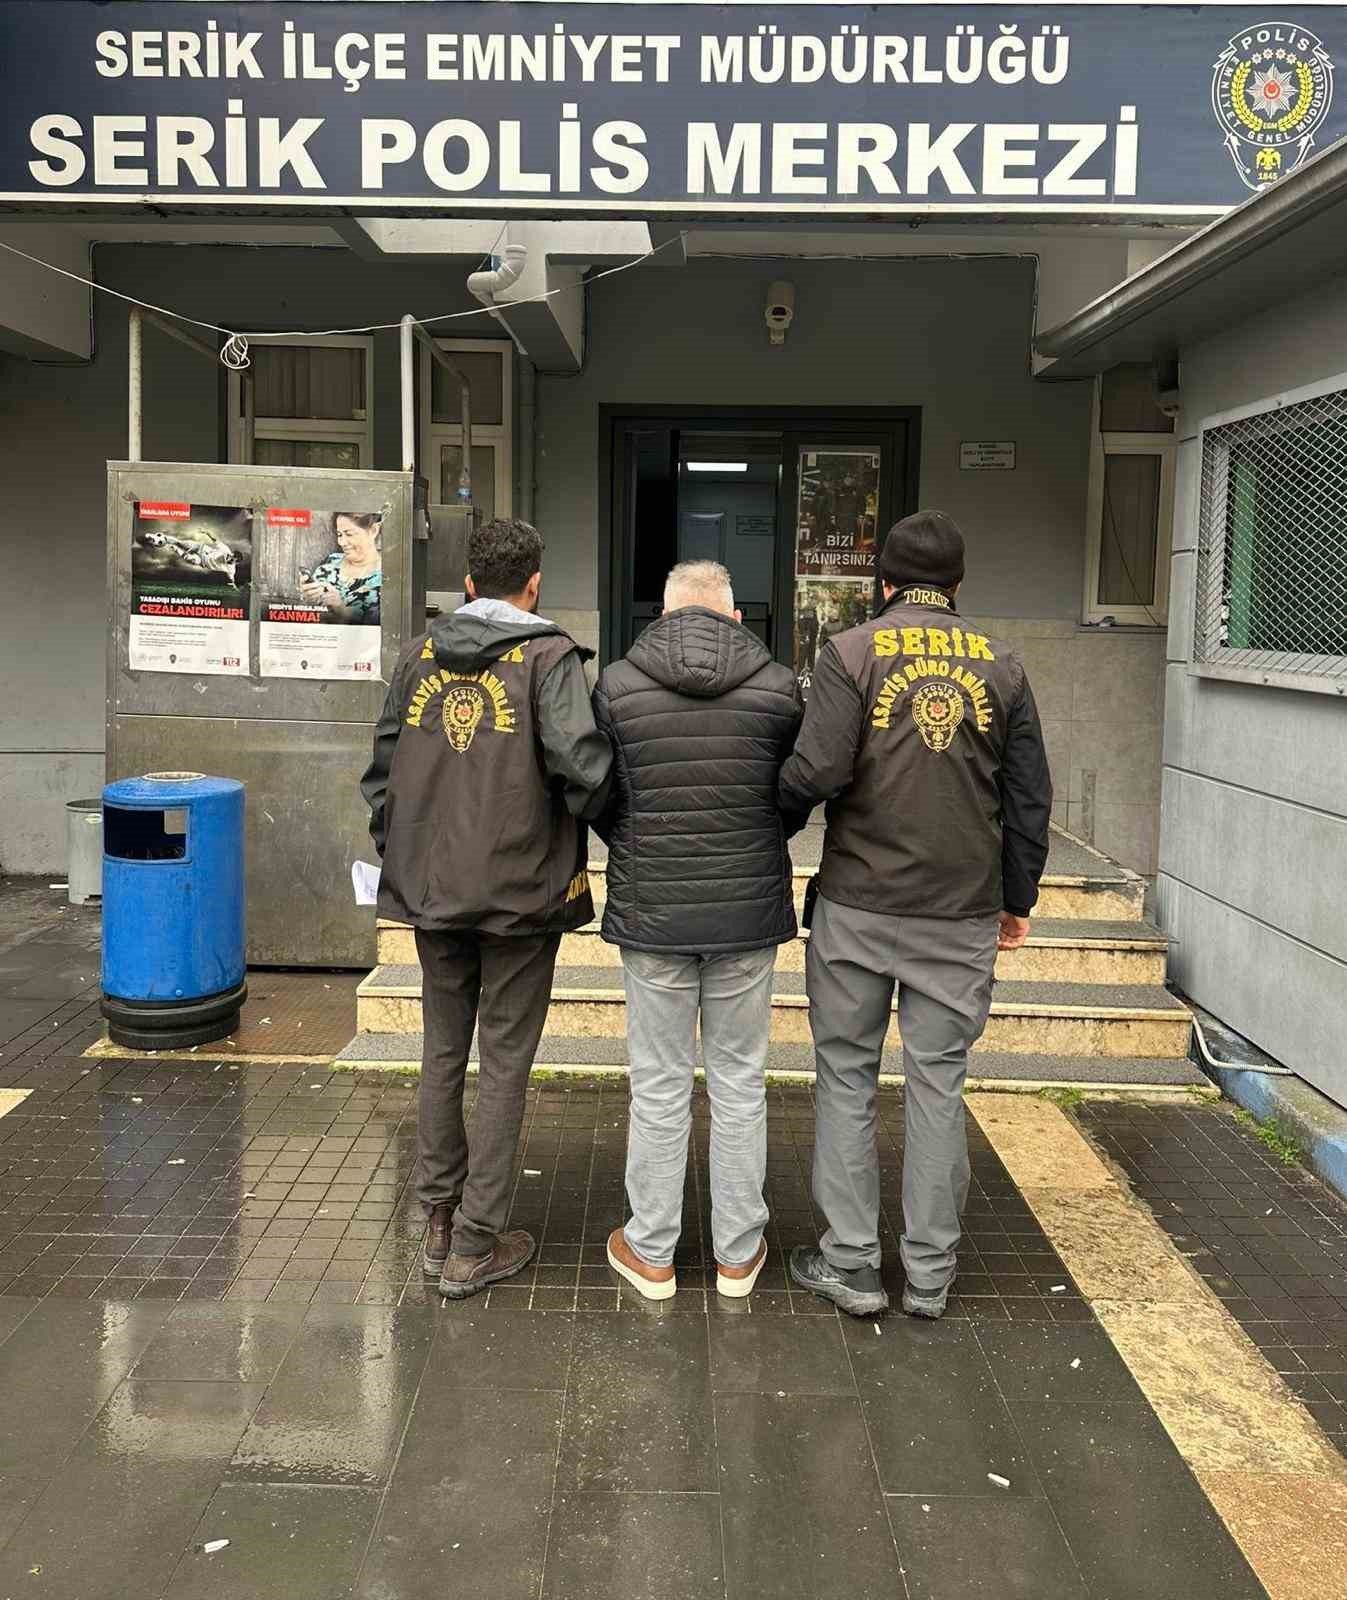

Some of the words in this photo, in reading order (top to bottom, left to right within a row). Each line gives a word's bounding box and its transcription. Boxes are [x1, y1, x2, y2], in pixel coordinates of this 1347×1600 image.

[1241, 29, 1310, 51] POLİS
[96, 21, 264, 78] SERİK
[284, 21, 405, 92] İLÇE
[427, 24, 680, 82] EMNİYET
[701, 24, 1069, 84] MÜDÜRLÜĞÜ
[1247, 131, 1291, 143] GENEL
[29, 100, 326, 188] SERİK
[362, 103, 648, 193] POLİS
[687, 106, 1138, 195] MERKEZİ
[826, 531, 854, 547] BİZİ
[803, 552, 876, 567] TANIRSINIZ
[139, 603, 244, 619] CEZALANDIRILIR!
[194, 599, 221, 607] OYUNU
[269, 610, 321, 622] KANMA!
[873, 627, 995, 661] SERİK
[872, 673, 909, 729] ASAYİŞ
[903, 657, 949, 681] BÜRO
